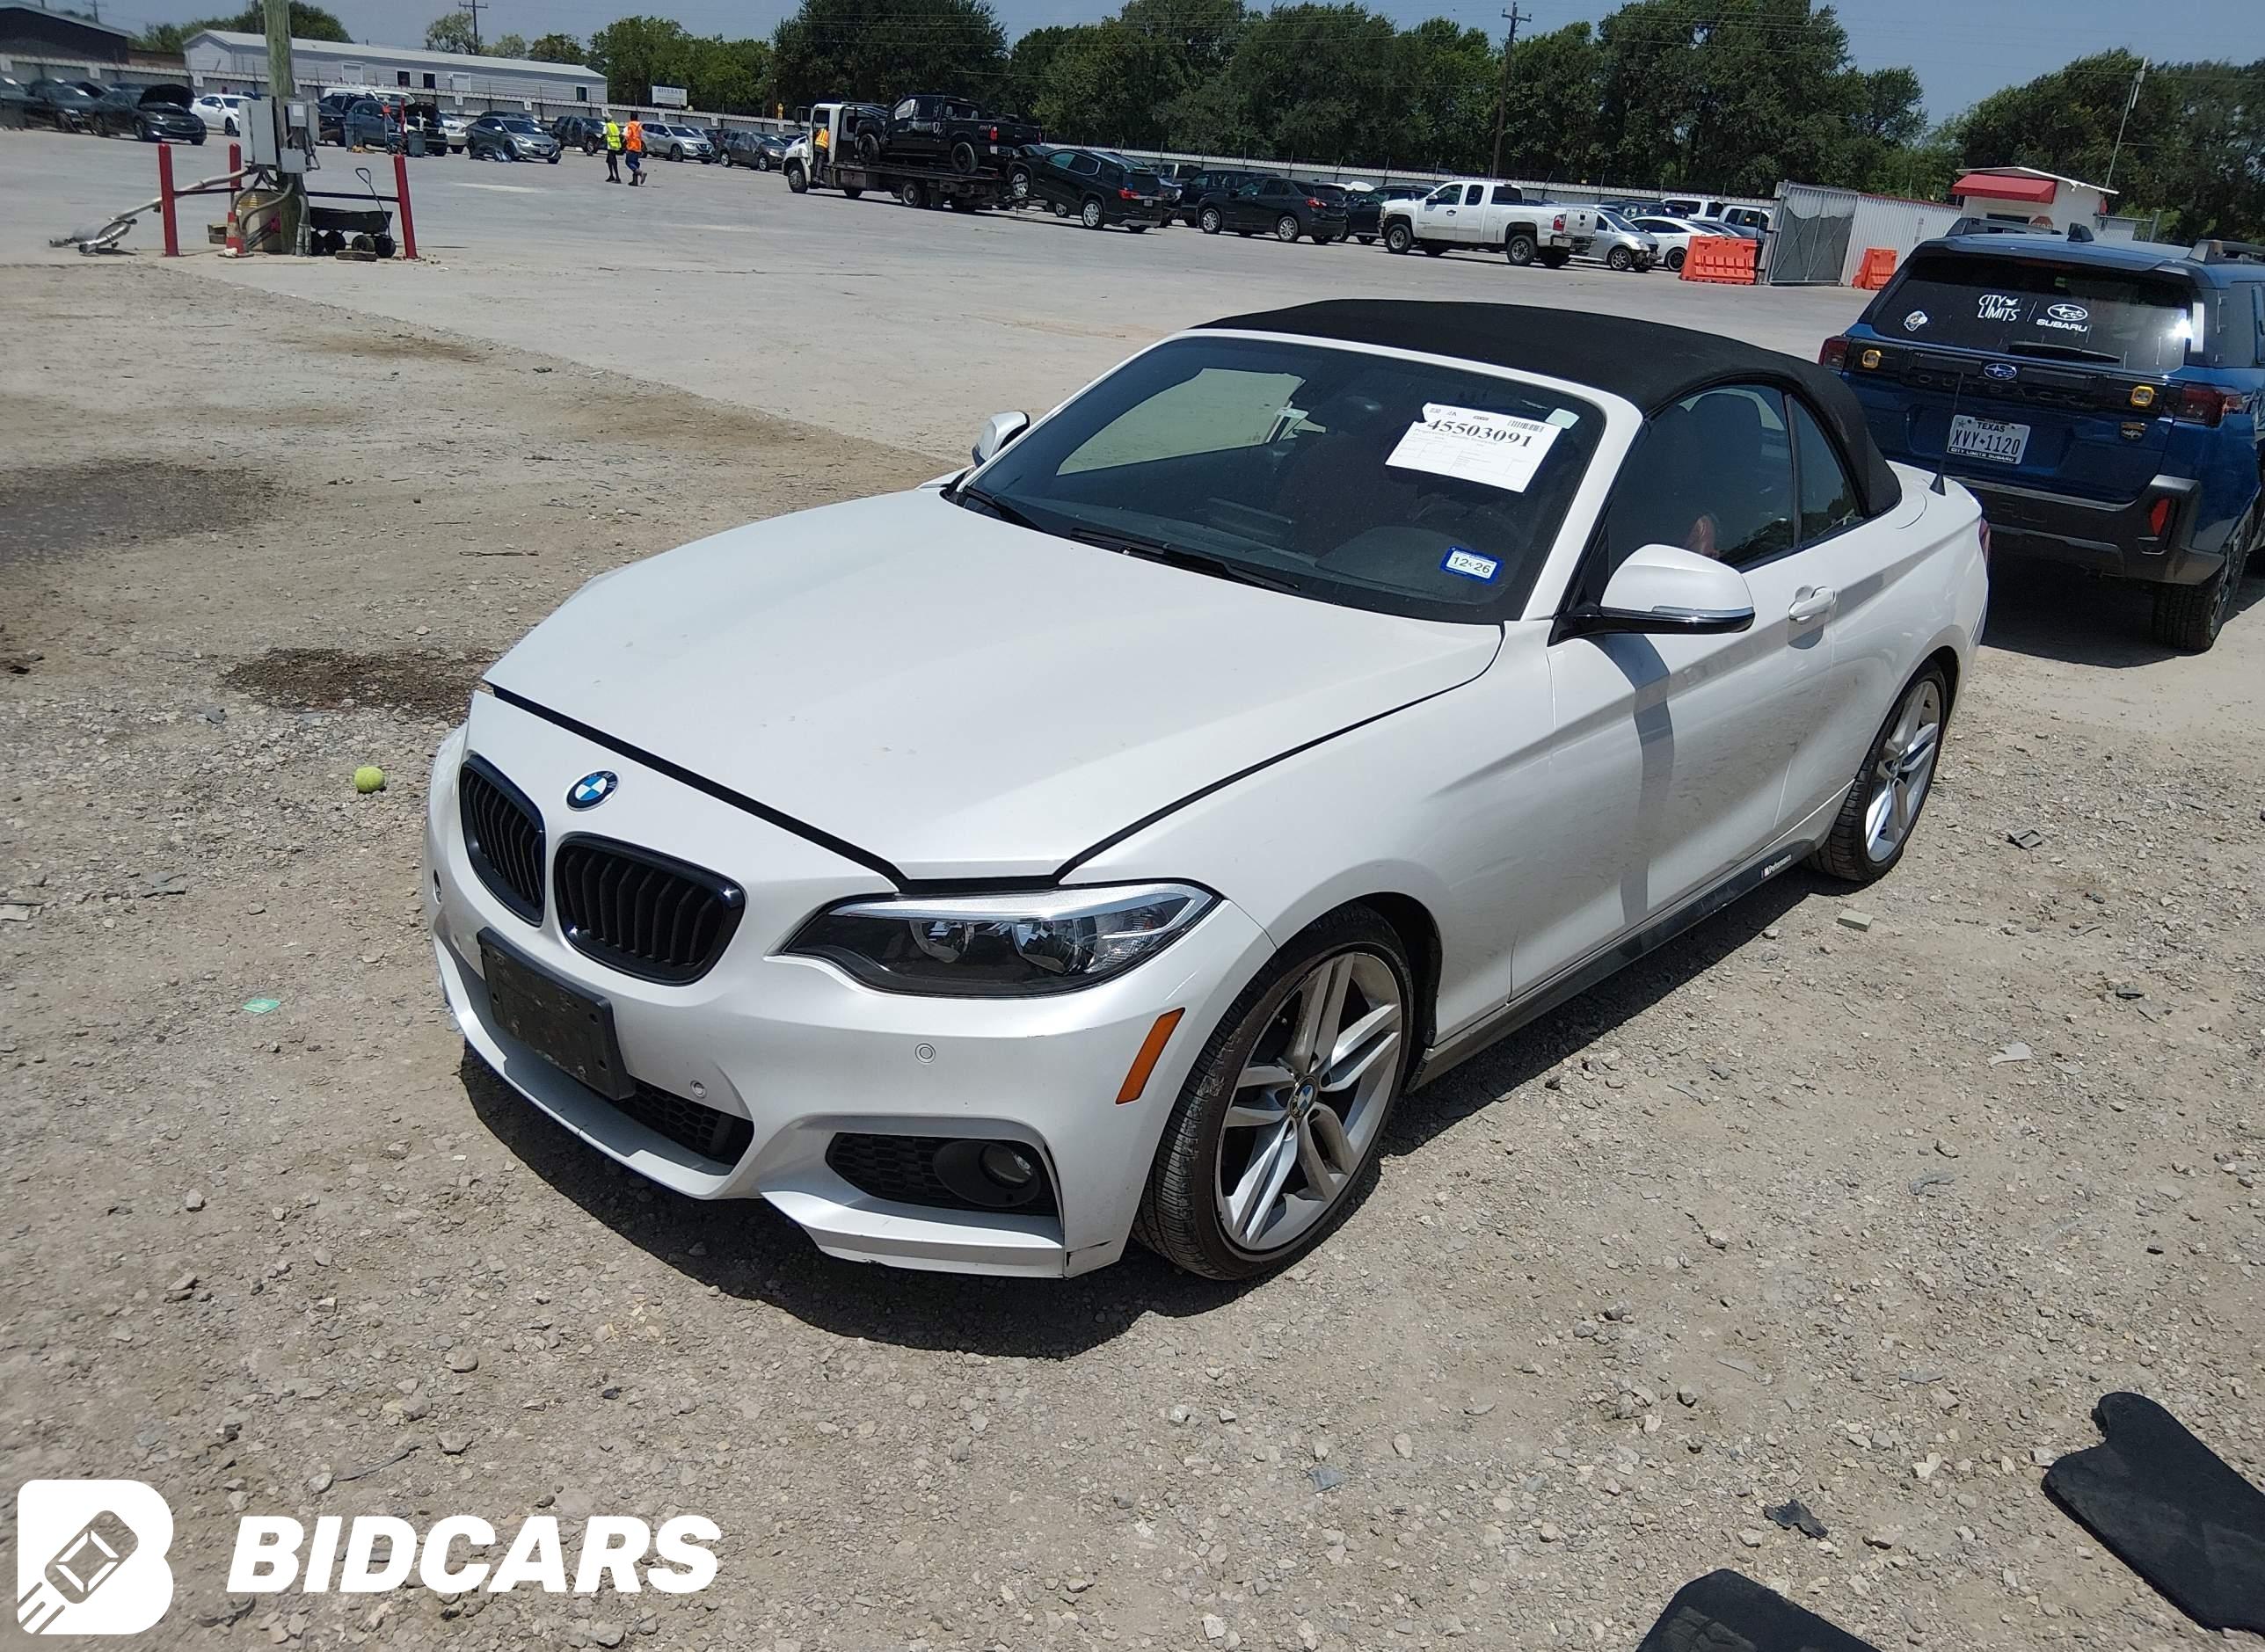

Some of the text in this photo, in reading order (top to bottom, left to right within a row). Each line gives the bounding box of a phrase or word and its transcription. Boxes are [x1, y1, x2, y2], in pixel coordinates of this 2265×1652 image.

[1978, 295, 2007, 307] CITY
[1977, 305, 2021, 322] LIMITS
[2036, 318, 2088, 332] SUBARU
[1427, 419, 1533, 448] 45503091
[1977, 422, 2006, 433] TEXAS
